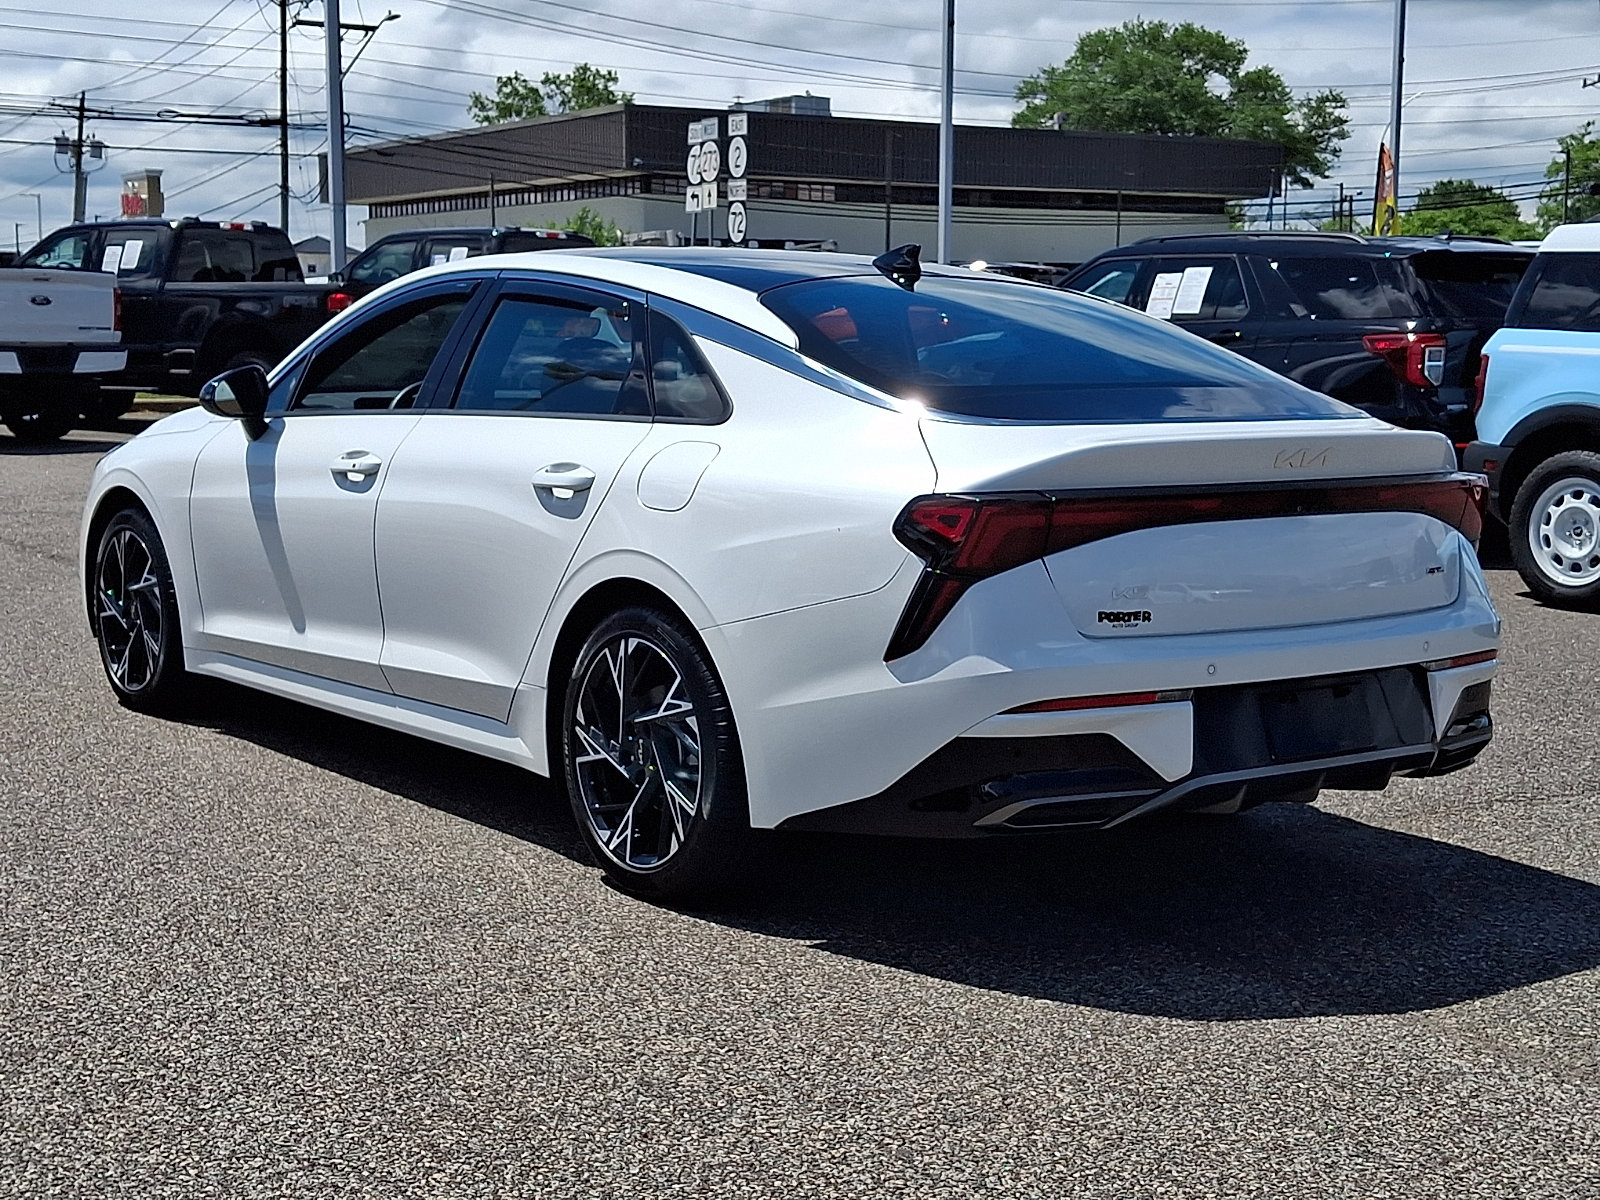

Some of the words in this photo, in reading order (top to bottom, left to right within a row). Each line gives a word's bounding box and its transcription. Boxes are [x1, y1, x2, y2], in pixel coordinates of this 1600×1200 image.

[702, 150, 718, 173] 273
[734, 145, 741, 168] 2
[731, 211, 744, 234] 72
[1097, 610, 1153, 624] PORTER
